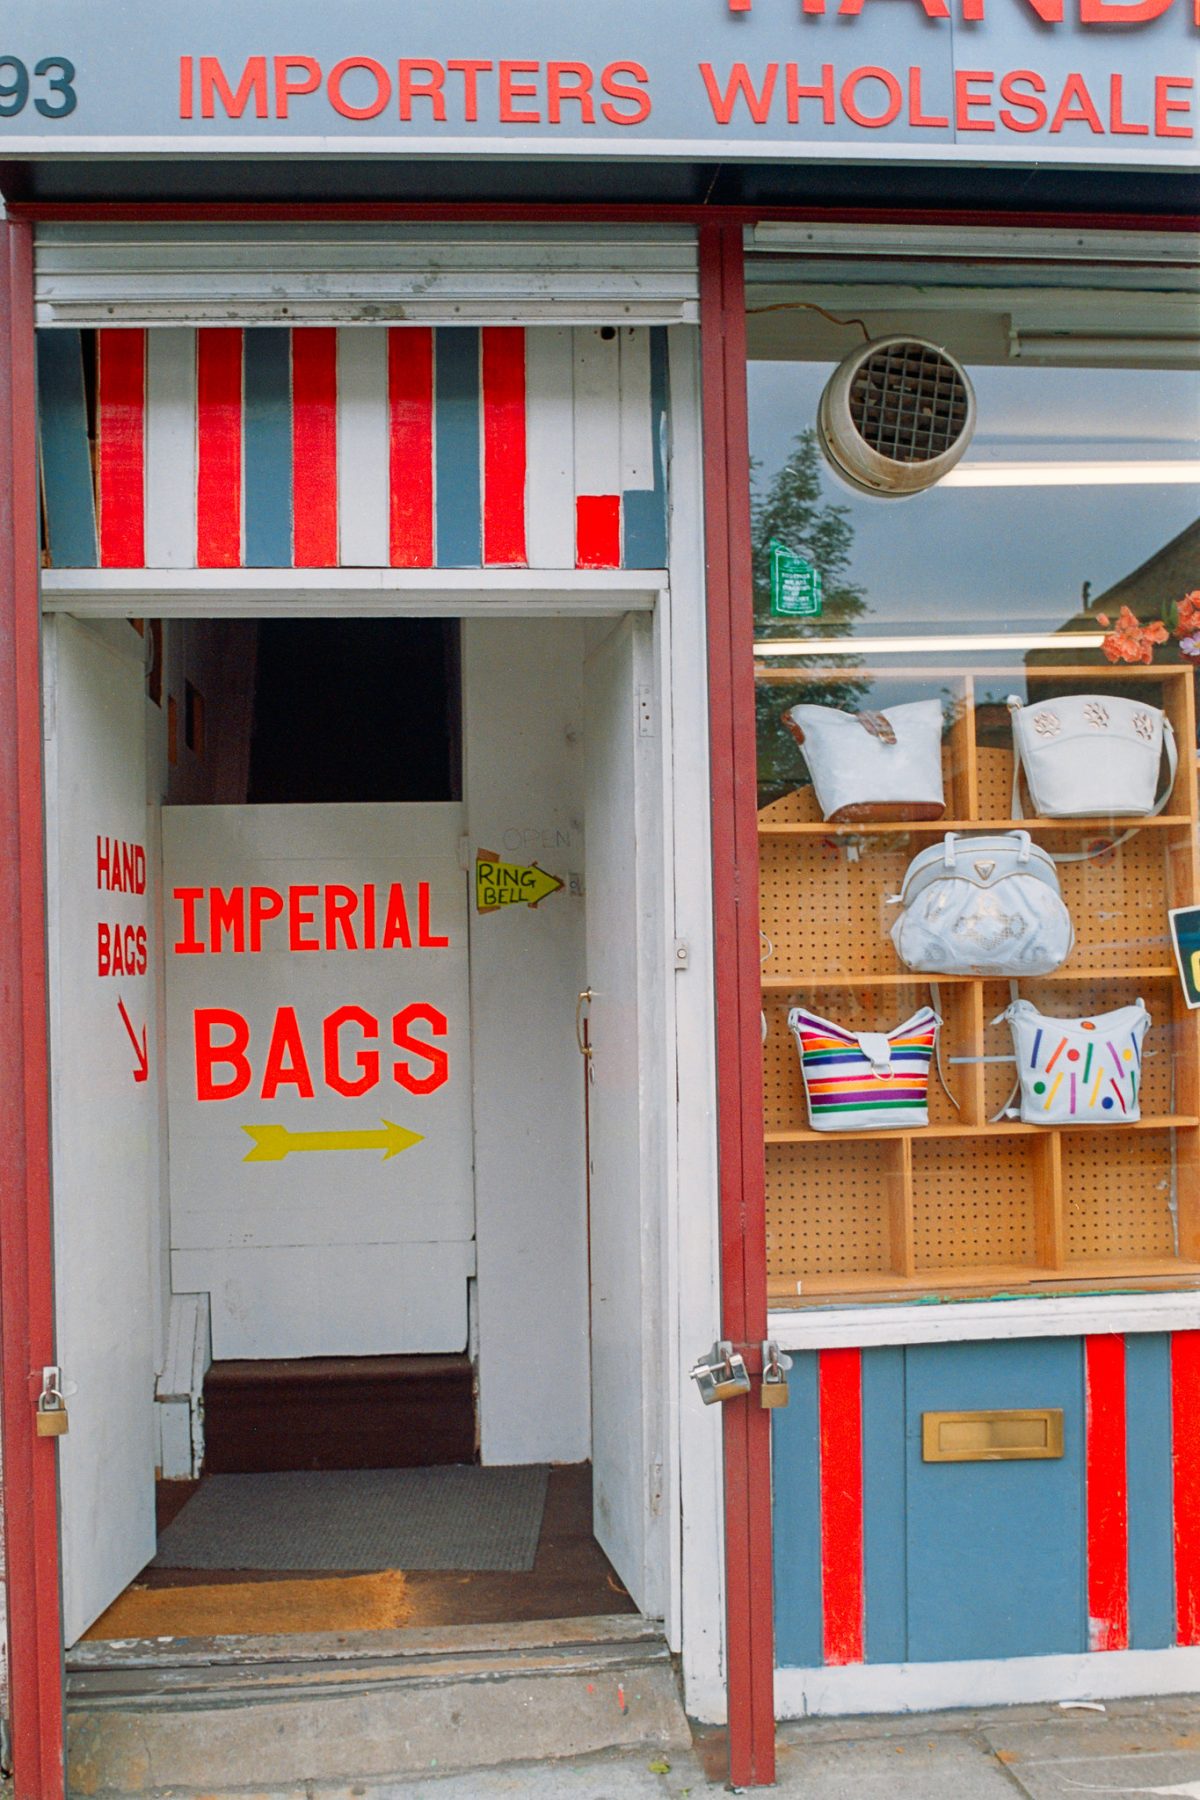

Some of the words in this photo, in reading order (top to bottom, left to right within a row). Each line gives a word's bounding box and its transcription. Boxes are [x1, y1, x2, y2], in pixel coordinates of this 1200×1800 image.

[0, 55, 77, 118] 93
[179, 55, 652, 125] IMPORTERS
[699, 63, 1195, 138] WHOLESALE
[97, 835, 146, 895] HAND
[502, 827, 571, 852] OPEN
[478, 863, 536, 888] RING
[484, 887, 529, 905] BELL
[173, 882, 449, 954] IMPERIAL
[98, 922, 147, 977] BAGS
[194, 1002, 449, 1101] BAGS
